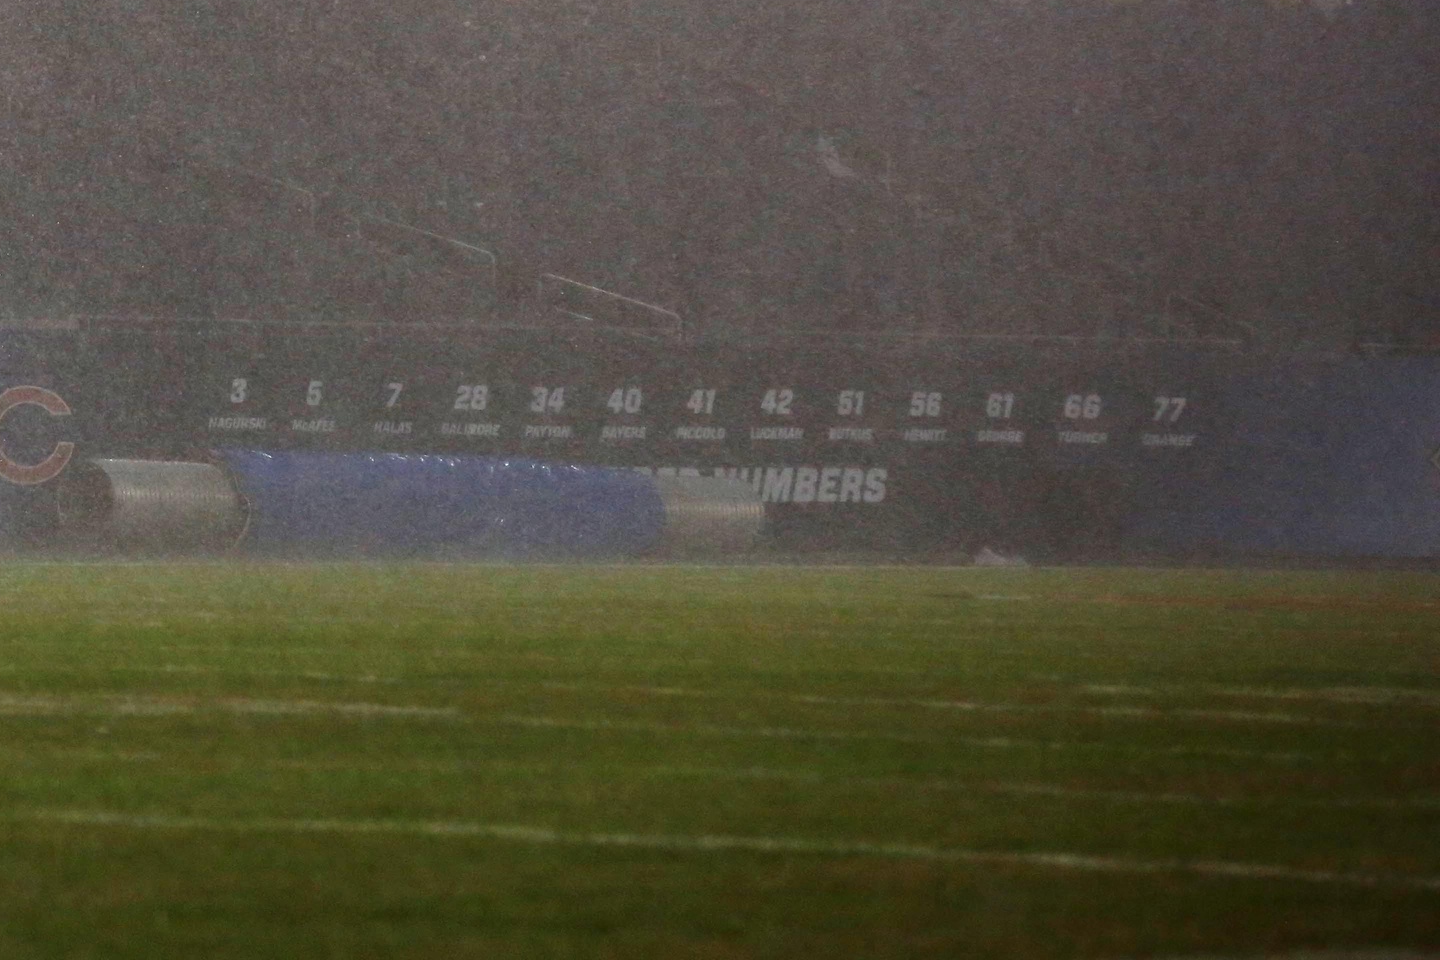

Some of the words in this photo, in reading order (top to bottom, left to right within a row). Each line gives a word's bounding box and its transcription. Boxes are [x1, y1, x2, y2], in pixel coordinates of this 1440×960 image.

[230, 378, 247, 403] 3
[306, 380, 323, 406] 5
[386, 383, 404, 407] 7
[454, 384, 488, 410] 28
[530, 386, 565, 413] 34
[606, 387, 643, 414] 40
[686, 389, 716, 414] 41
[760, 388, 794, 415] 42
[837, 390, 865, 416] 51
[909, 391, 943, 417] 56
[986, 392, 1015, 418] 61
[1064, 394, 1102, 419] 66
[1153, 397, 1187, 422] 77
